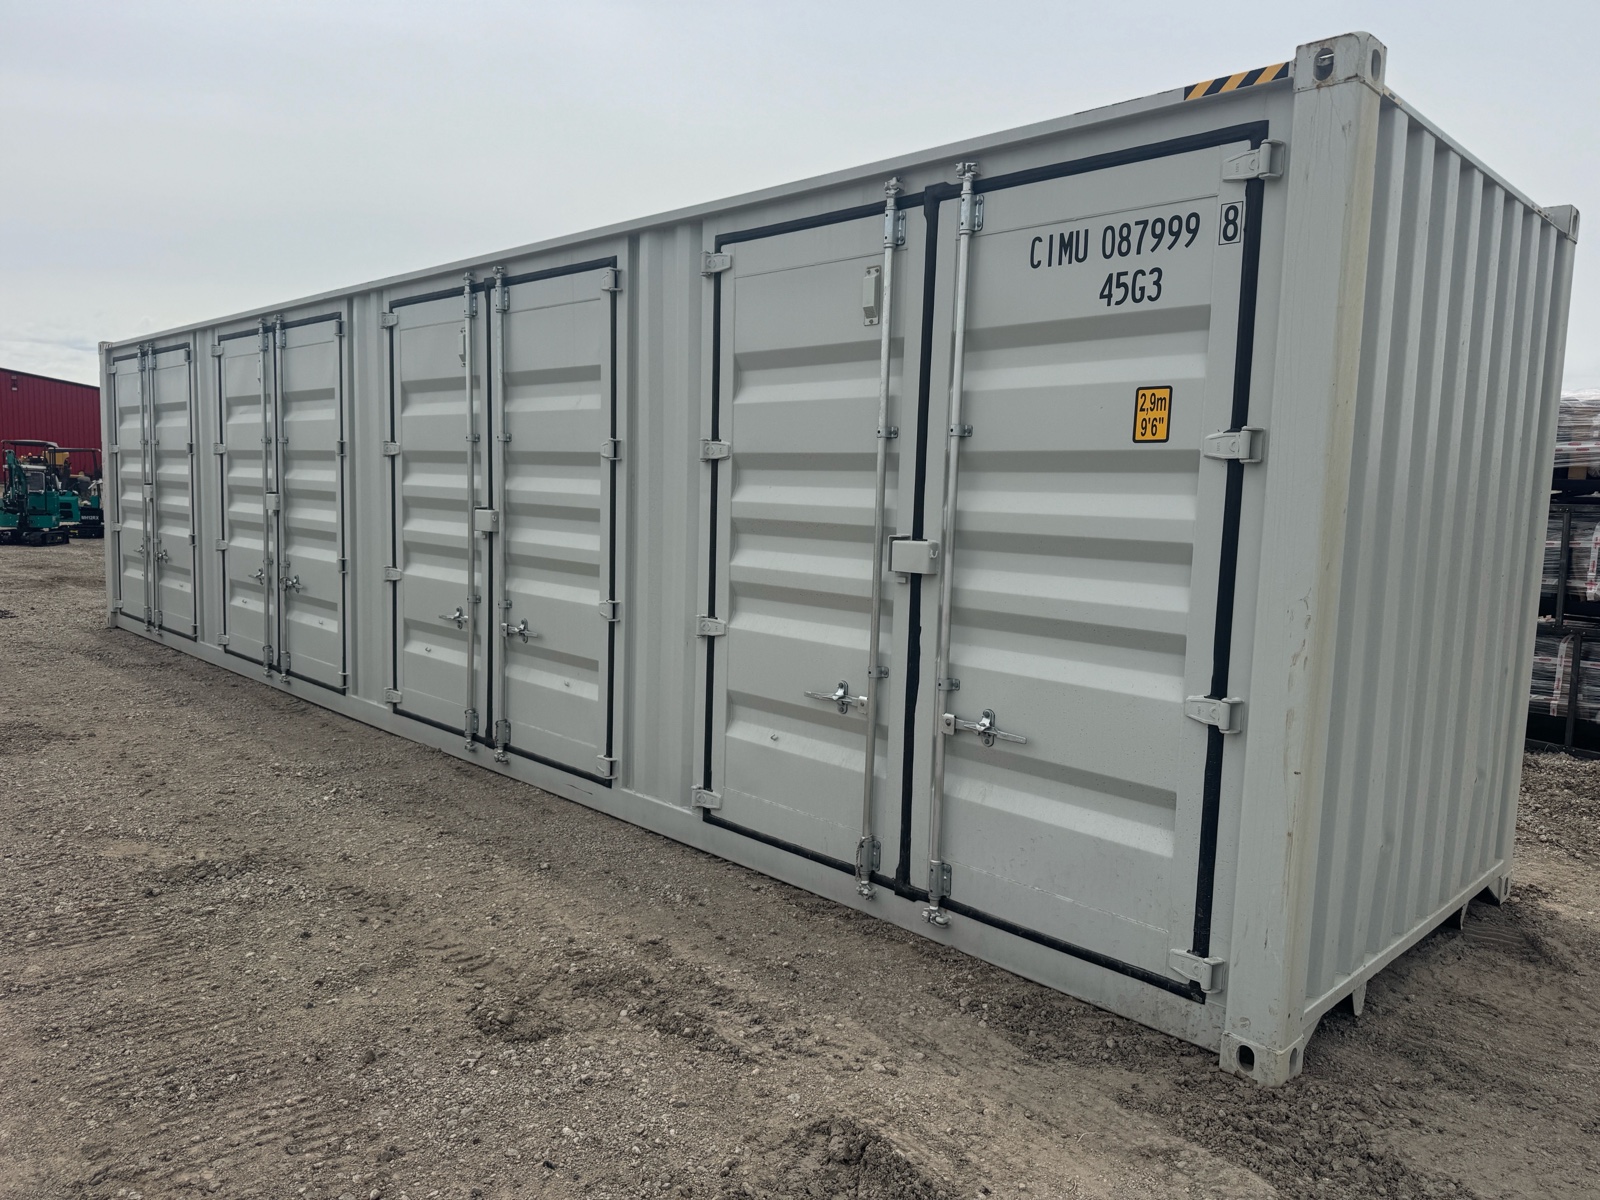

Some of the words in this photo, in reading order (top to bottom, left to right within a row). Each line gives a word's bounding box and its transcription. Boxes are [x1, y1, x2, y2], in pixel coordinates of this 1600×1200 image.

[1030, 229, 1089, 269] CIMU
[1101, 211, 1201, 260] 087999
[1222, 204, 1239, 242] 8
[1099, 267, 1163, 307] 45G3
[1139, 392, 1167, 415] 2,9m
[1140, 416, 1164, 437] 9'6"
